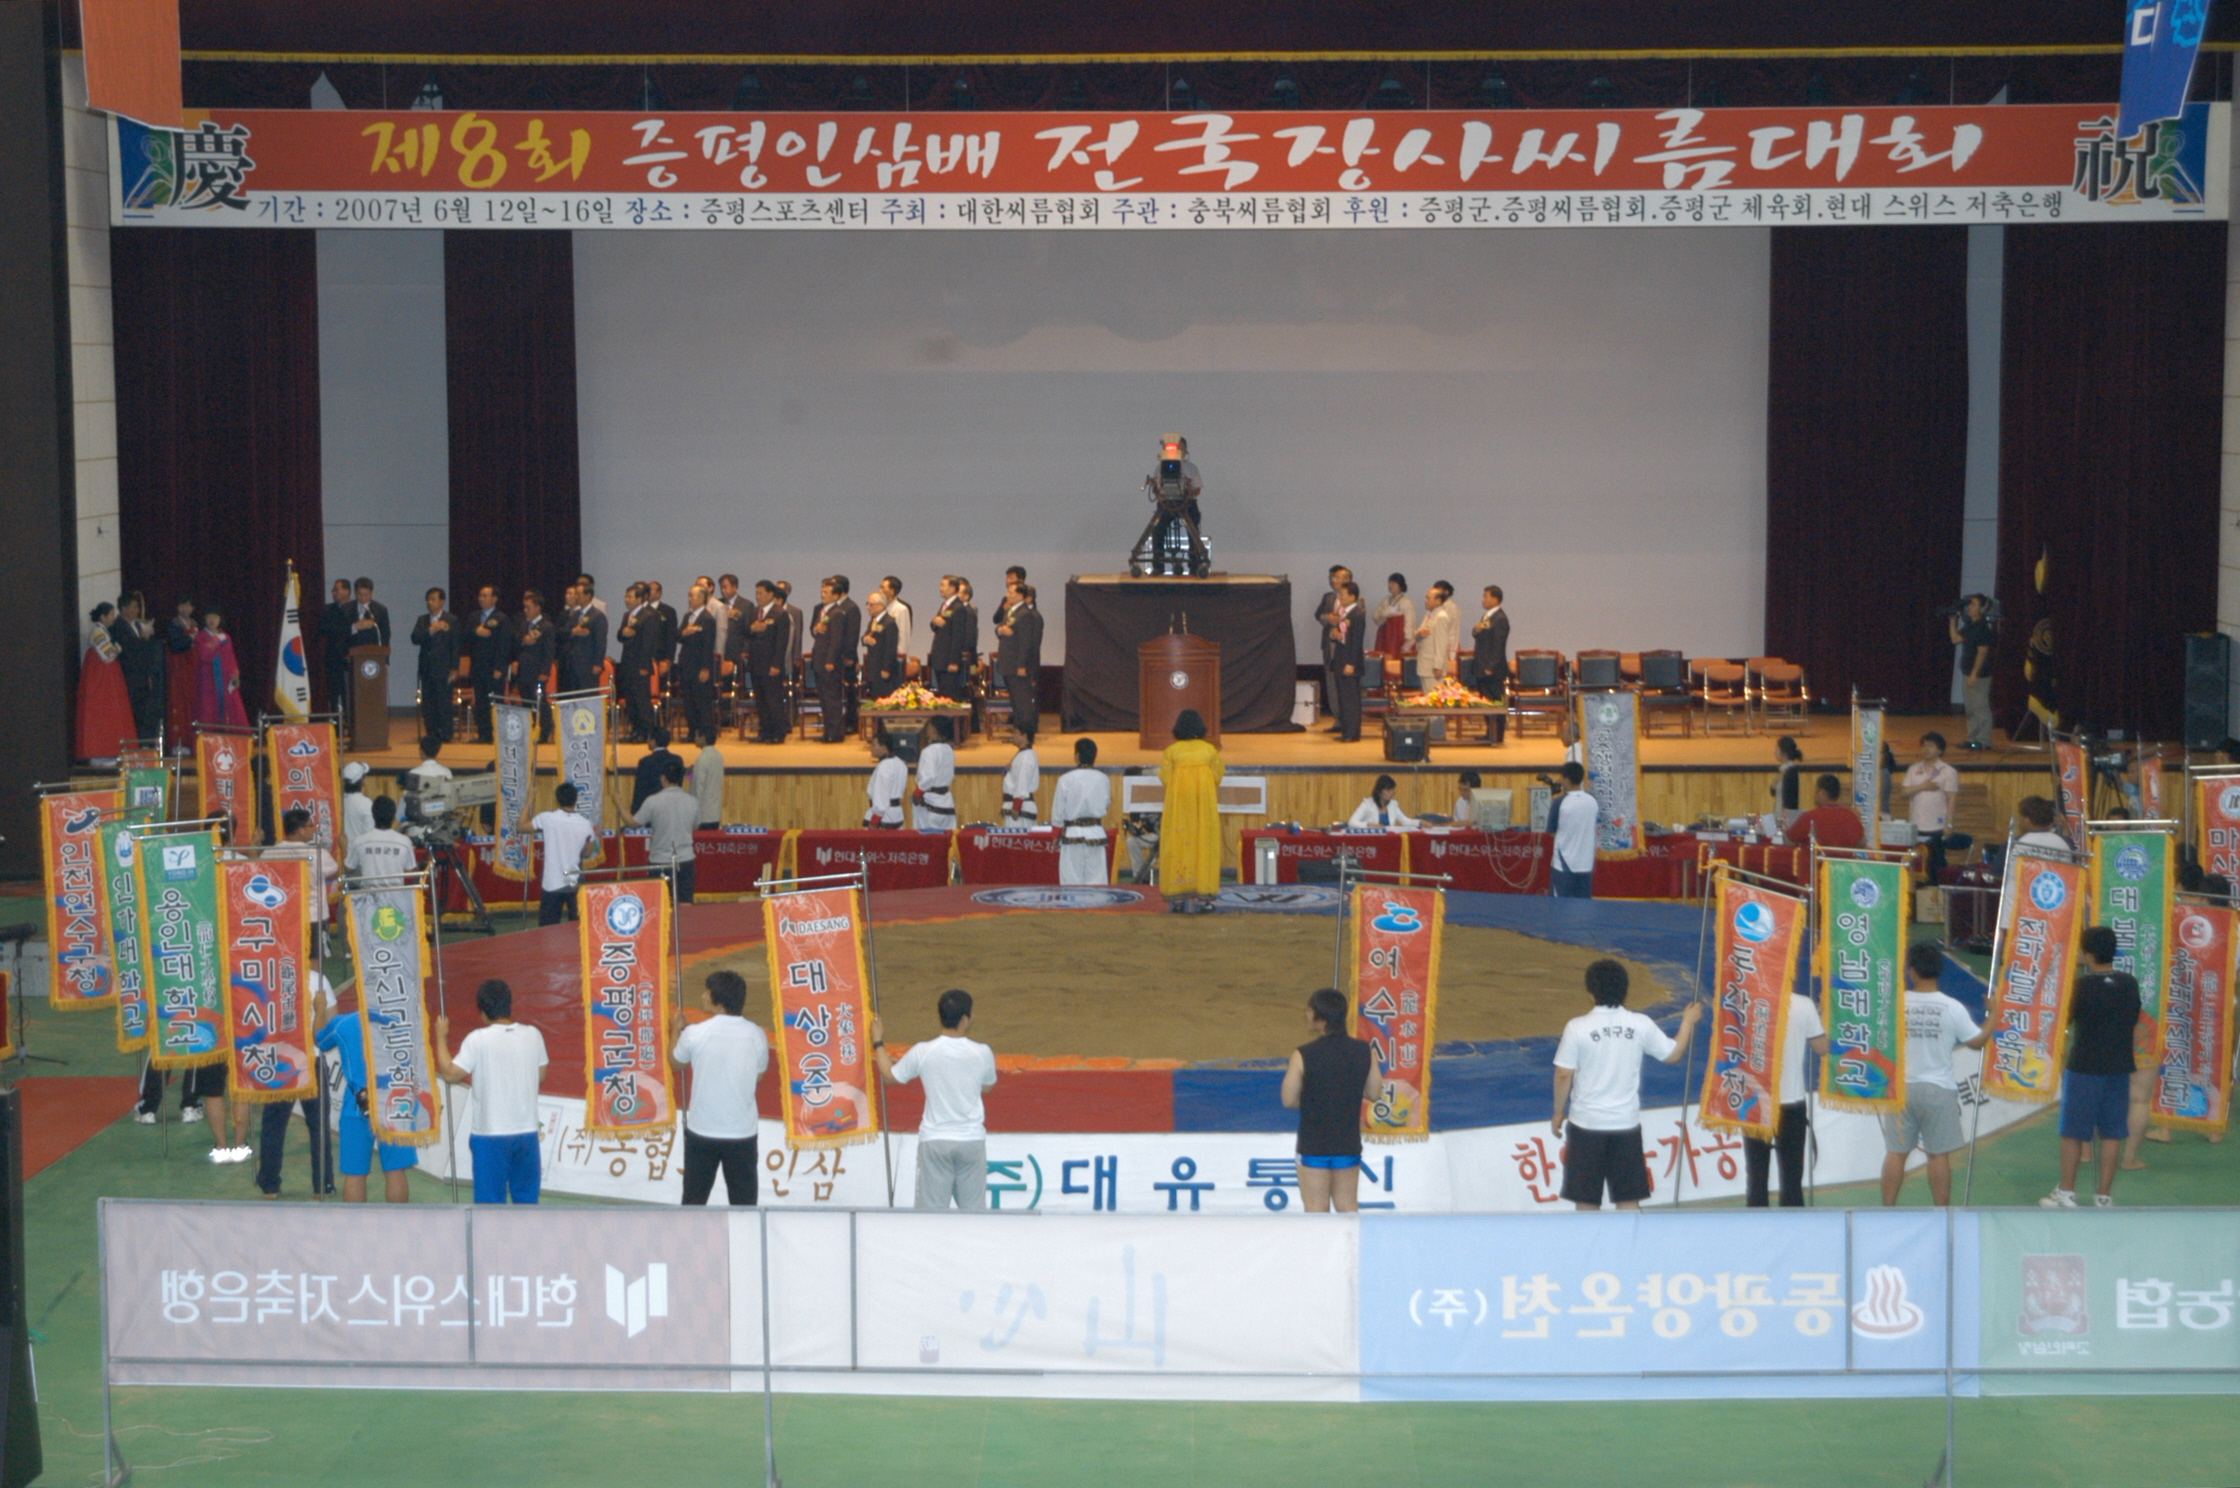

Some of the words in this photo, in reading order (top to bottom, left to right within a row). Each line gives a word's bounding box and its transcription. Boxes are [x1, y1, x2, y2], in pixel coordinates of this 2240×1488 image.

[168, 121, 253, 211] 慶
[335, 197, 422, 224] 2007년
[434, 197, 473, 224] 6월
[701, 197, 868, 226] 증평스포츠센터
[957, 197, 1101, 226] 대한씨름협회
[1187, 197, 1332, 226] 충북씨름협회
[361, 112, 591, 188] 제8회
[622, 118, 1001, 189] 증평인삼배
[60, 840, 98, 992] 인천연수구청
[156, 887, 201, 1046] 용인대학교
[799, 916, 849, 935] DAESANG
[237, 917, 276, 1083] 구미시청
[369, 948, 415, 1121] 우신고등학교
[600, 941, 637, 1114] 증평군청
